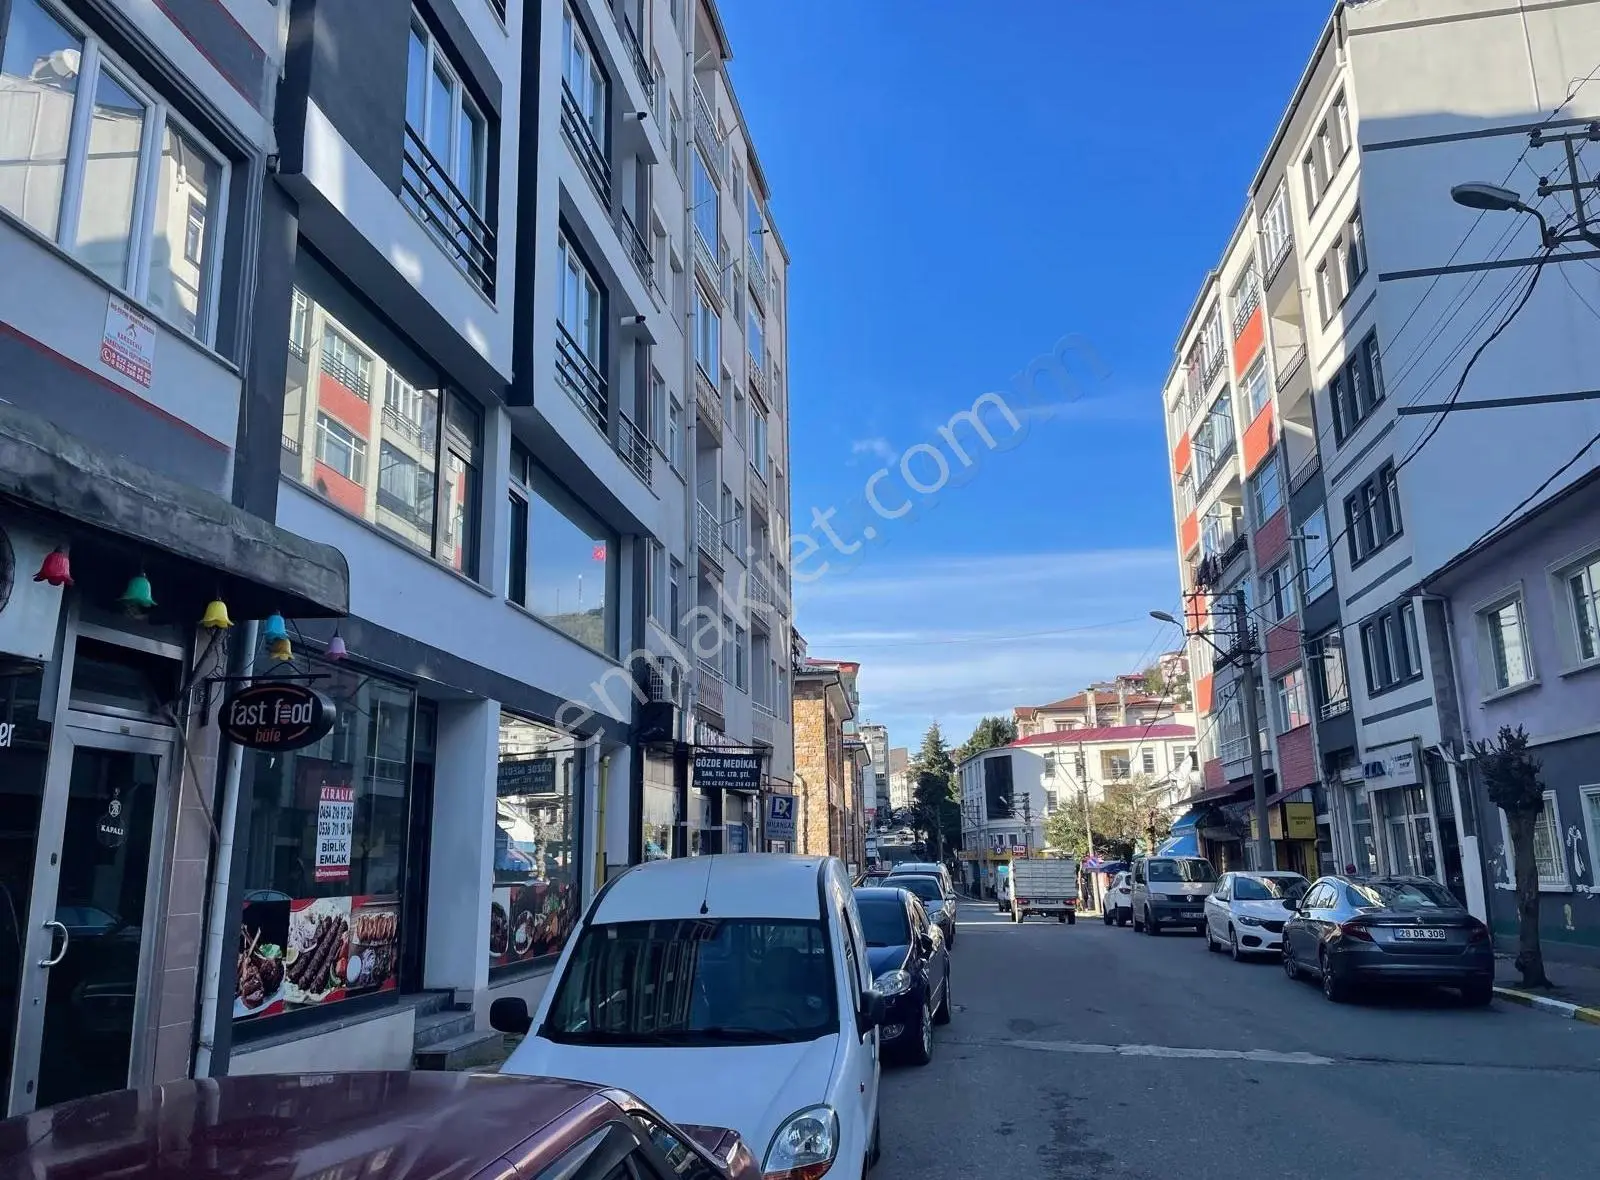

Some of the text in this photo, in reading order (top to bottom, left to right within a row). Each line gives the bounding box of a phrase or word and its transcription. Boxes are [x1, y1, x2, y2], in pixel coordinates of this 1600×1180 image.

[229, 697, 314, 726] fast food
[255, 727, 281, 743] büfe
[695, 757, 758, 769] GÖZDE MEDİKAL
[101, 824, 124, 836] KAPALI
[321, 840, 346, 853] BİRLİK
[320, 854, 347, 865] EMLAK
[1400, 929, 1445, 938] 28 DR 308
